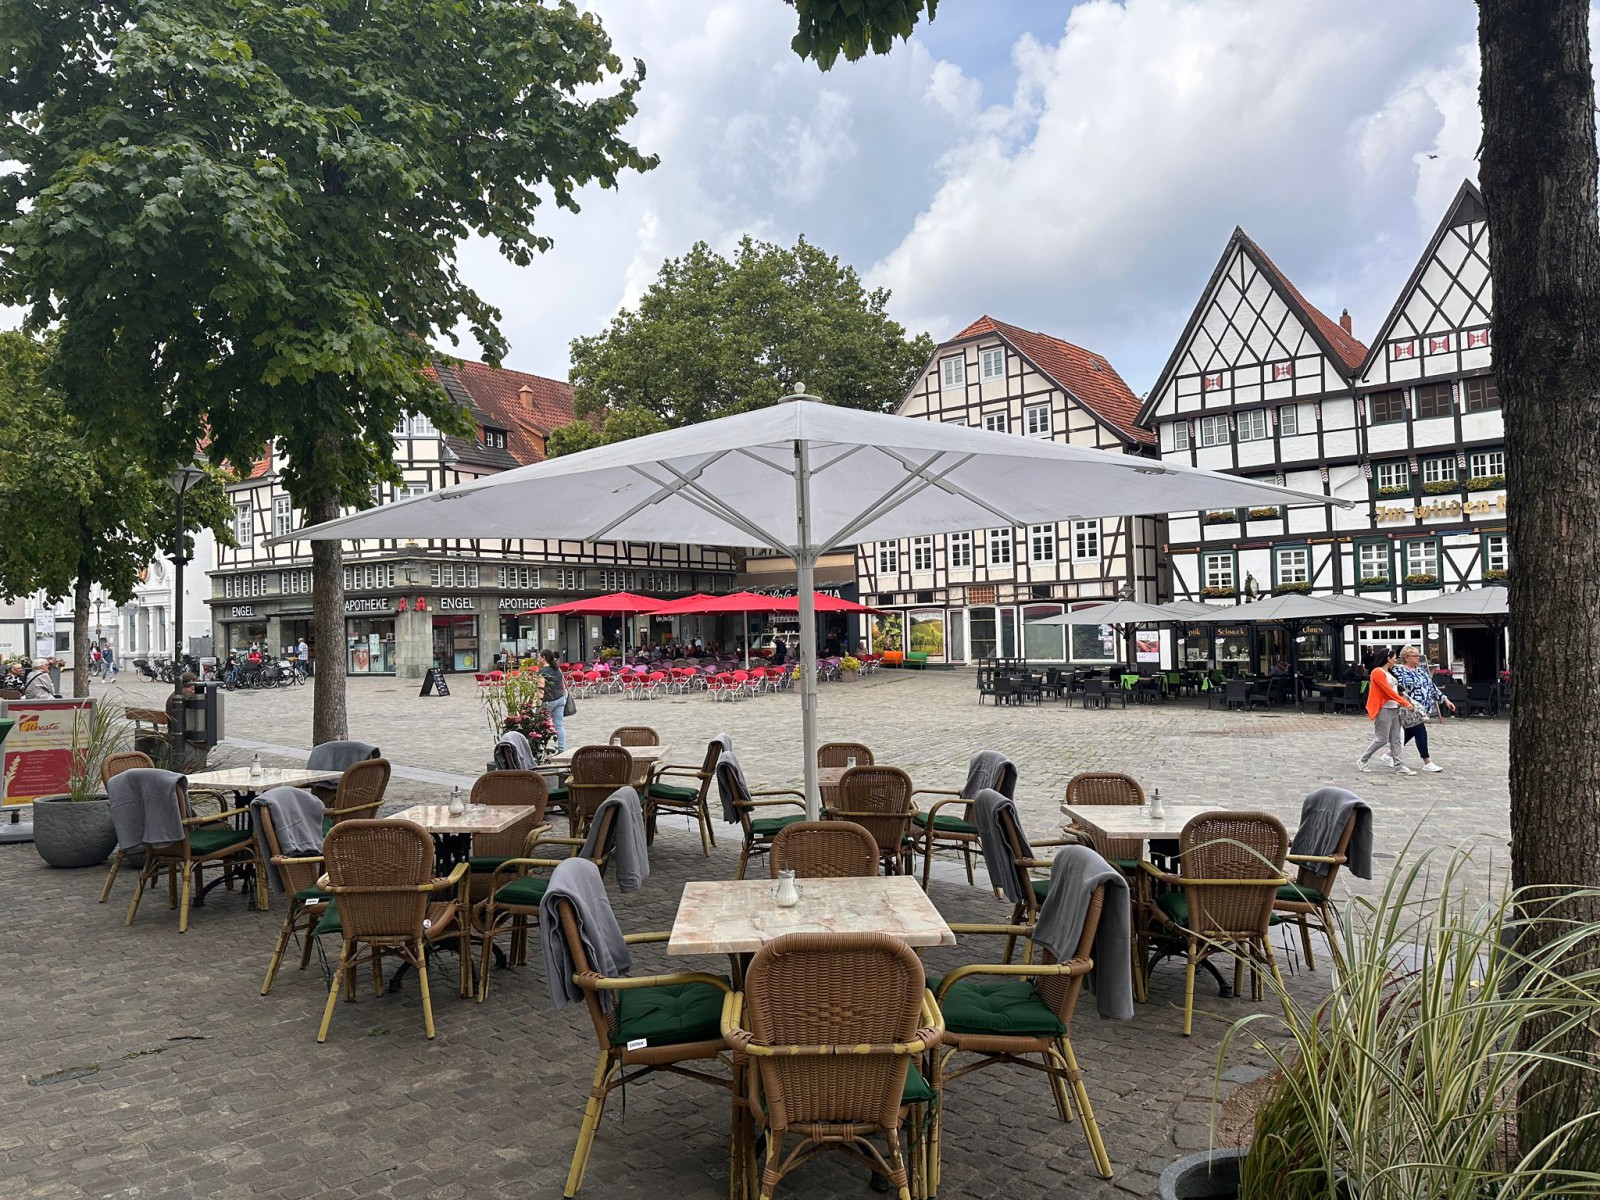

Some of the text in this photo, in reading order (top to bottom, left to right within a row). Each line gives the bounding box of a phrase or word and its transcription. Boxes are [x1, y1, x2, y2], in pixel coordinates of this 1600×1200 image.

[1413, 499, 1490, 519] wilden
[232, 598, 387, 617] ENGEL APOTHEKE
[441, 597, 546, 609] ENGEL APOTHEKE
